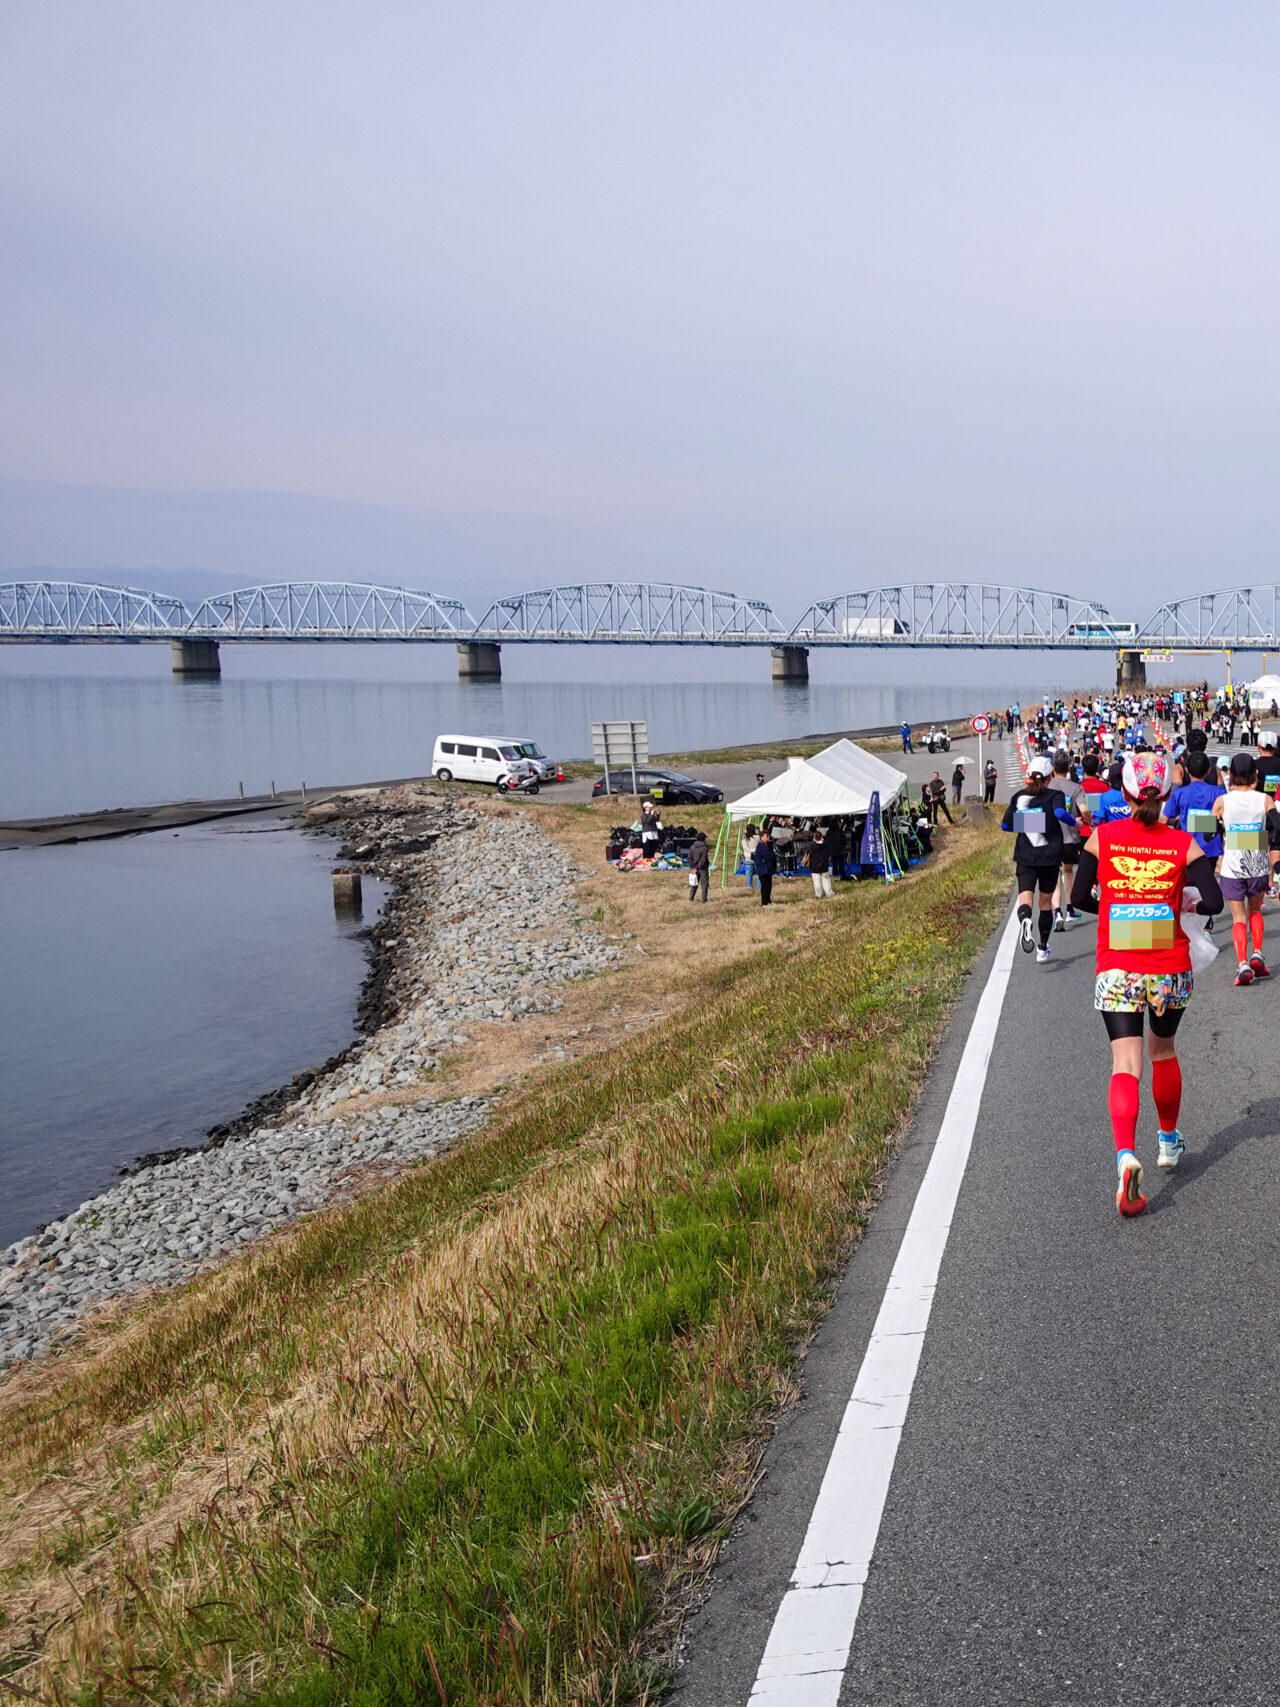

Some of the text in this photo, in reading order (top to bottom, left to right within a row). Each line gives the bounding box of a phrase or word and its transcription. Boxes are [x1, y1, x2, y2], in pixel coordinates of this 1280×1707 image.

[1109, 844, 1126, 852] We're
[1127, 846, 1152, 855] HENTAI
[1117, 857, 1131, 874] KAN
[1151, 861, 1168, 875] TRA
[1111, 906, 1170, 918] ワークスタッフ
